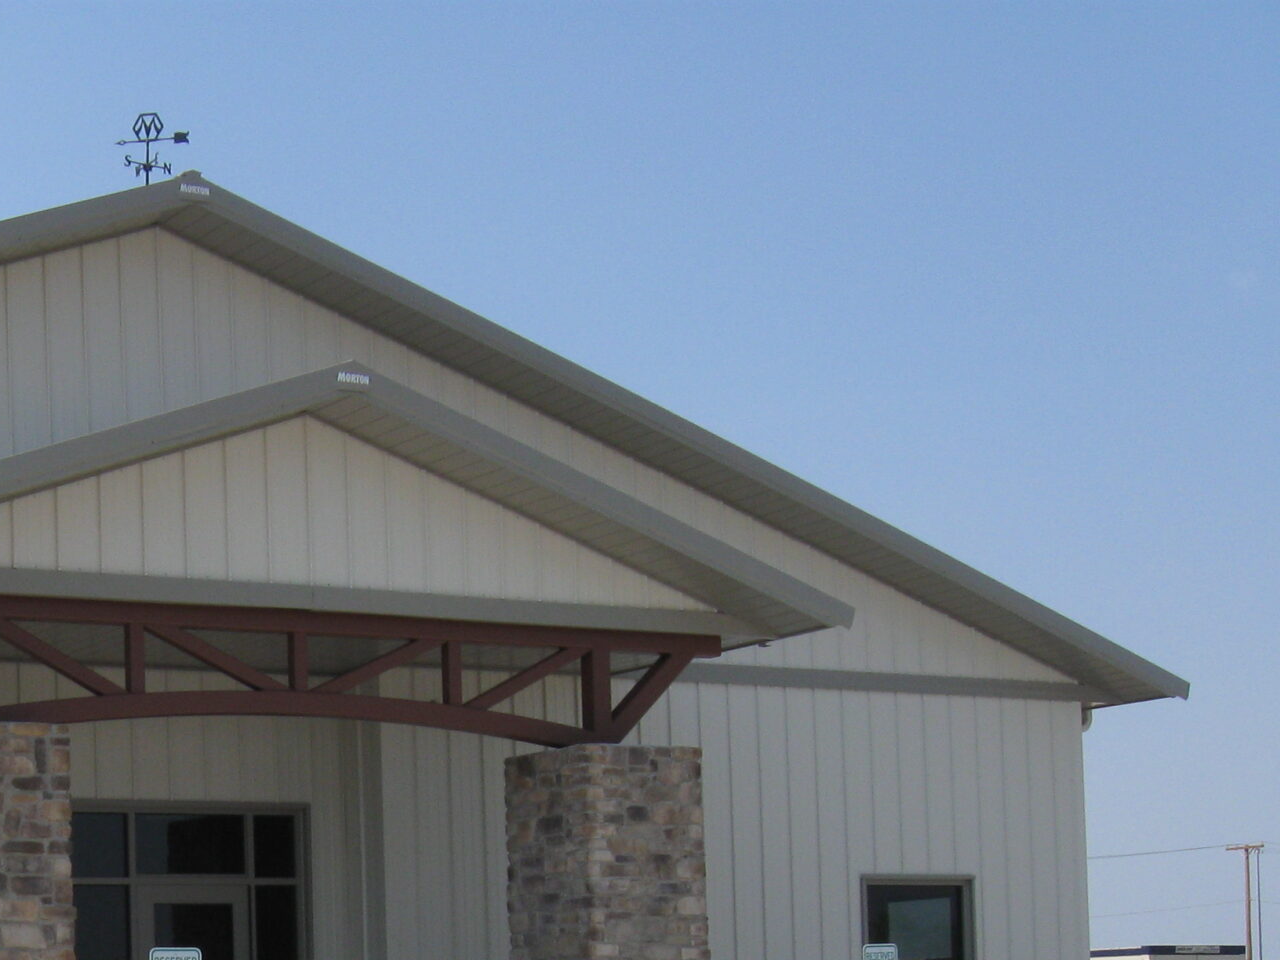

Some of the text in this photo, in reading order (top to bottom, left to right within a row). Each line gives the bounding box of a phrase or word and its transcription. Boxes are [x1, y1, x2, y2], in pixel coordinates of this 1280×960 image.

[124, 155, 131, 167] S
[163, 162, 171, 175] N
[180, 183, 210, 195] MORTON
[337, 371, 369, 385] MORTON
[865, 952, 895, 960] RESERVED
